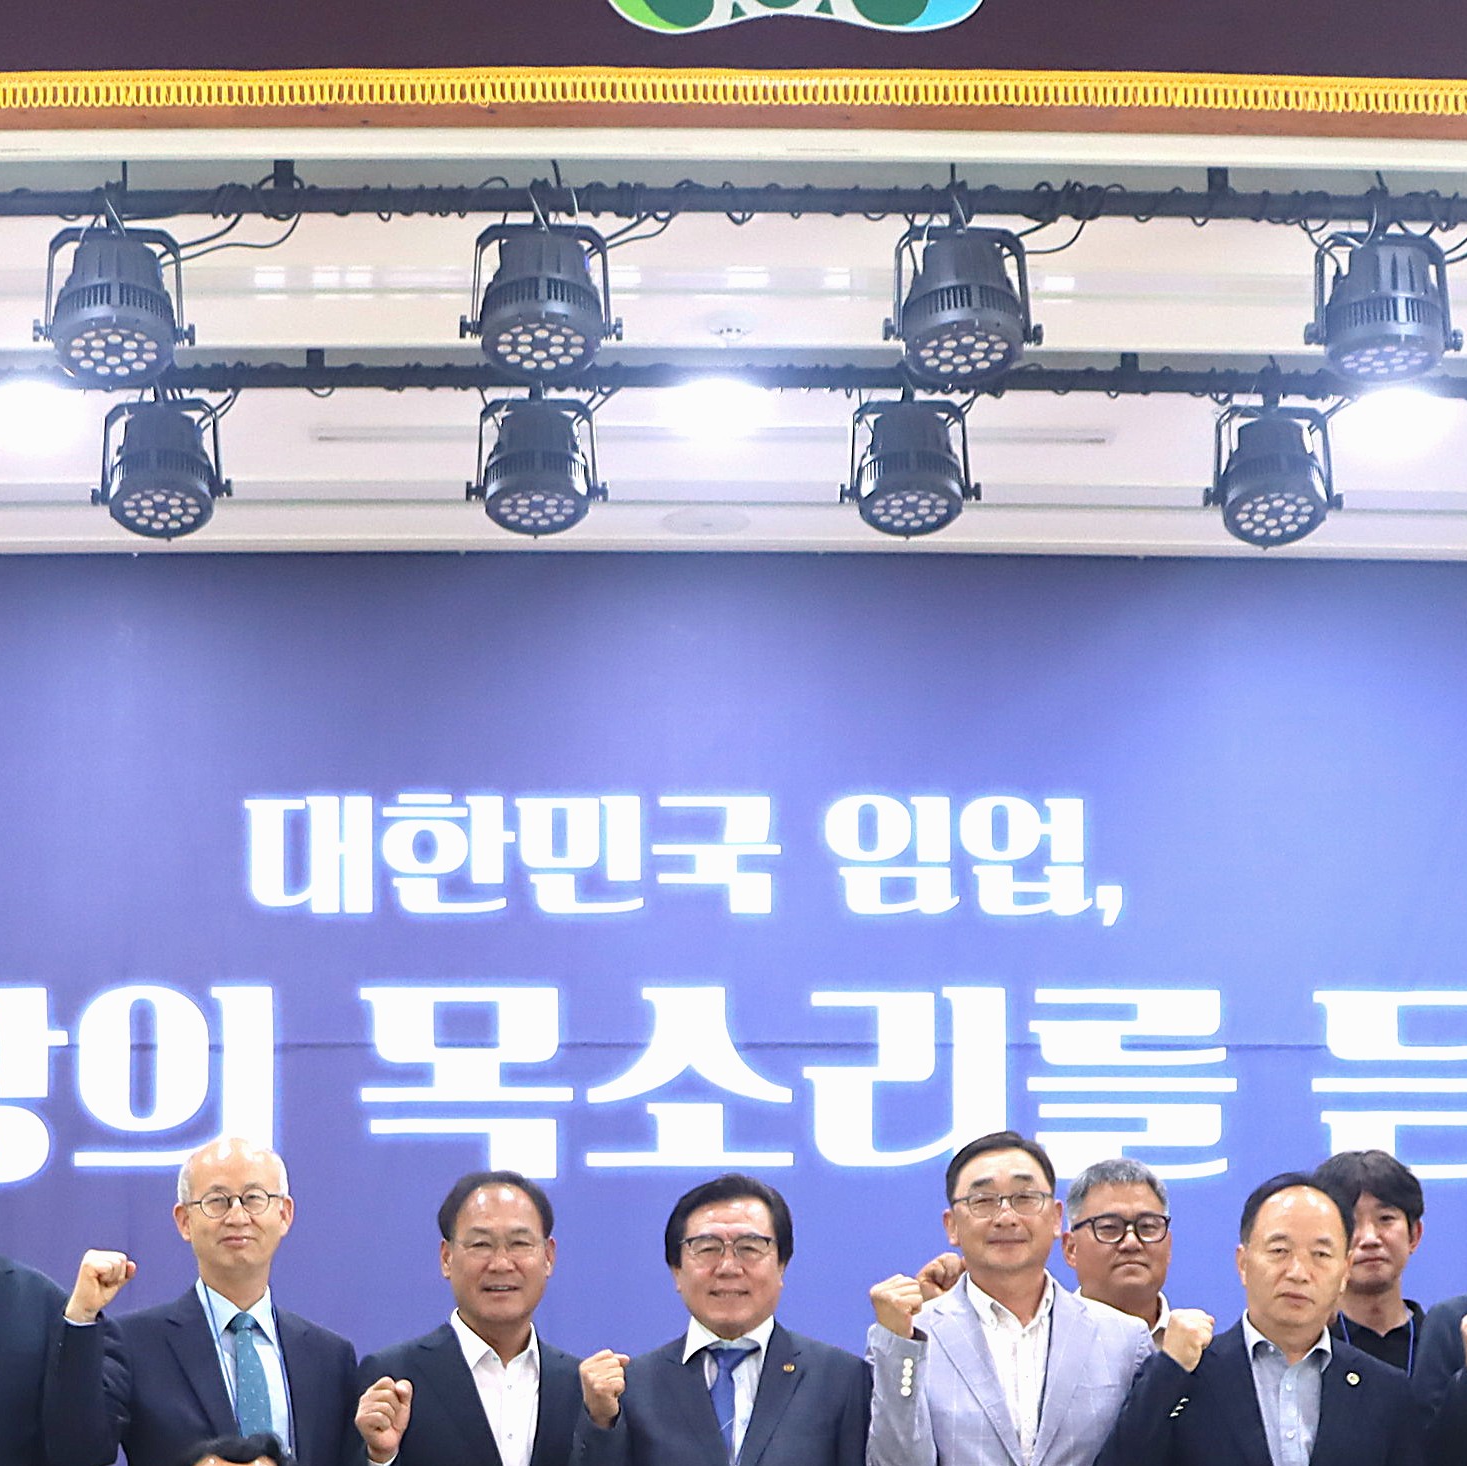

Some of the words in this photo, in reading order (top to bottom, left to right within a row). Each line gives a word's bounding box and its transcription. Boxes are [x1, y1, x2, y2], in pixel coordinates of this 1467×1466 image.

[244, 793, 782, 915] 대한민국
[824, 794, 1124, 927] 임업,
[359, 986, 1238, 1179] 목소리를
